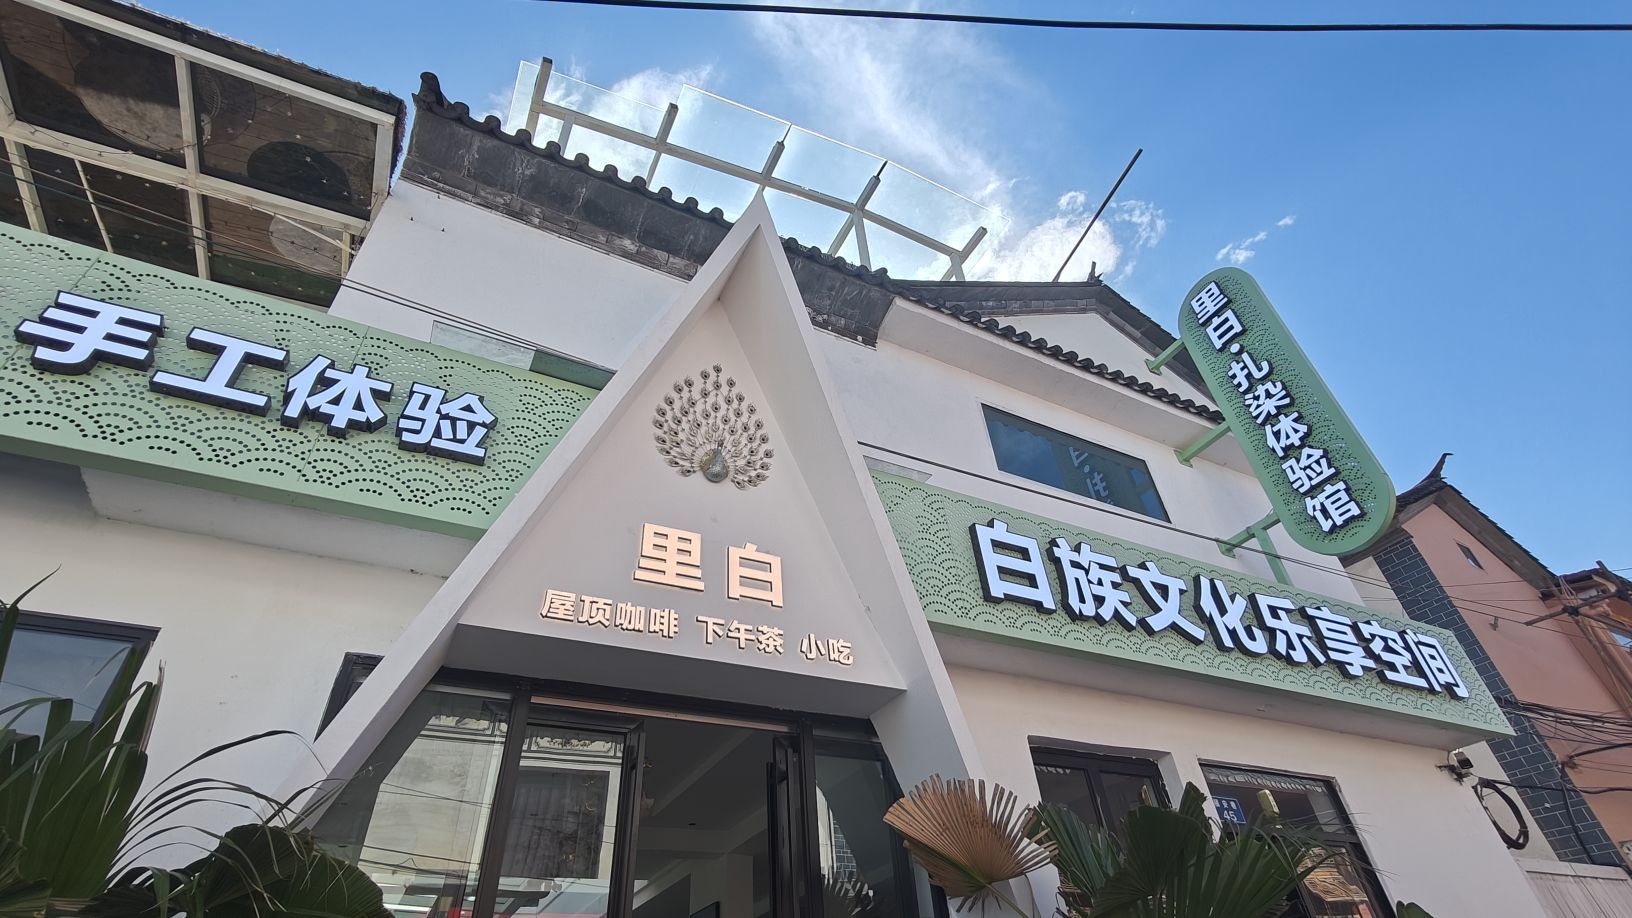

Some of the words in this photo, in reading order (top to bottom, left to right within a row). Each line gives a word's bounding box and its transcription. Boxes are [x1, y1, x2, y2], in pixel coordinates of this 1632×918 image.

[14, 290, 498, 465] 手工体验
[633, 522, 783, 608] 里白
[540, 589, 678, 638] 屋顶咖啡
[696, 615, 785, 654] 下午茶
[799, 633, 854, 665] 小吃
[970, 519, 1470, 699] 白族文化乐享空间
[1223, 810, 1238, 822] 45
